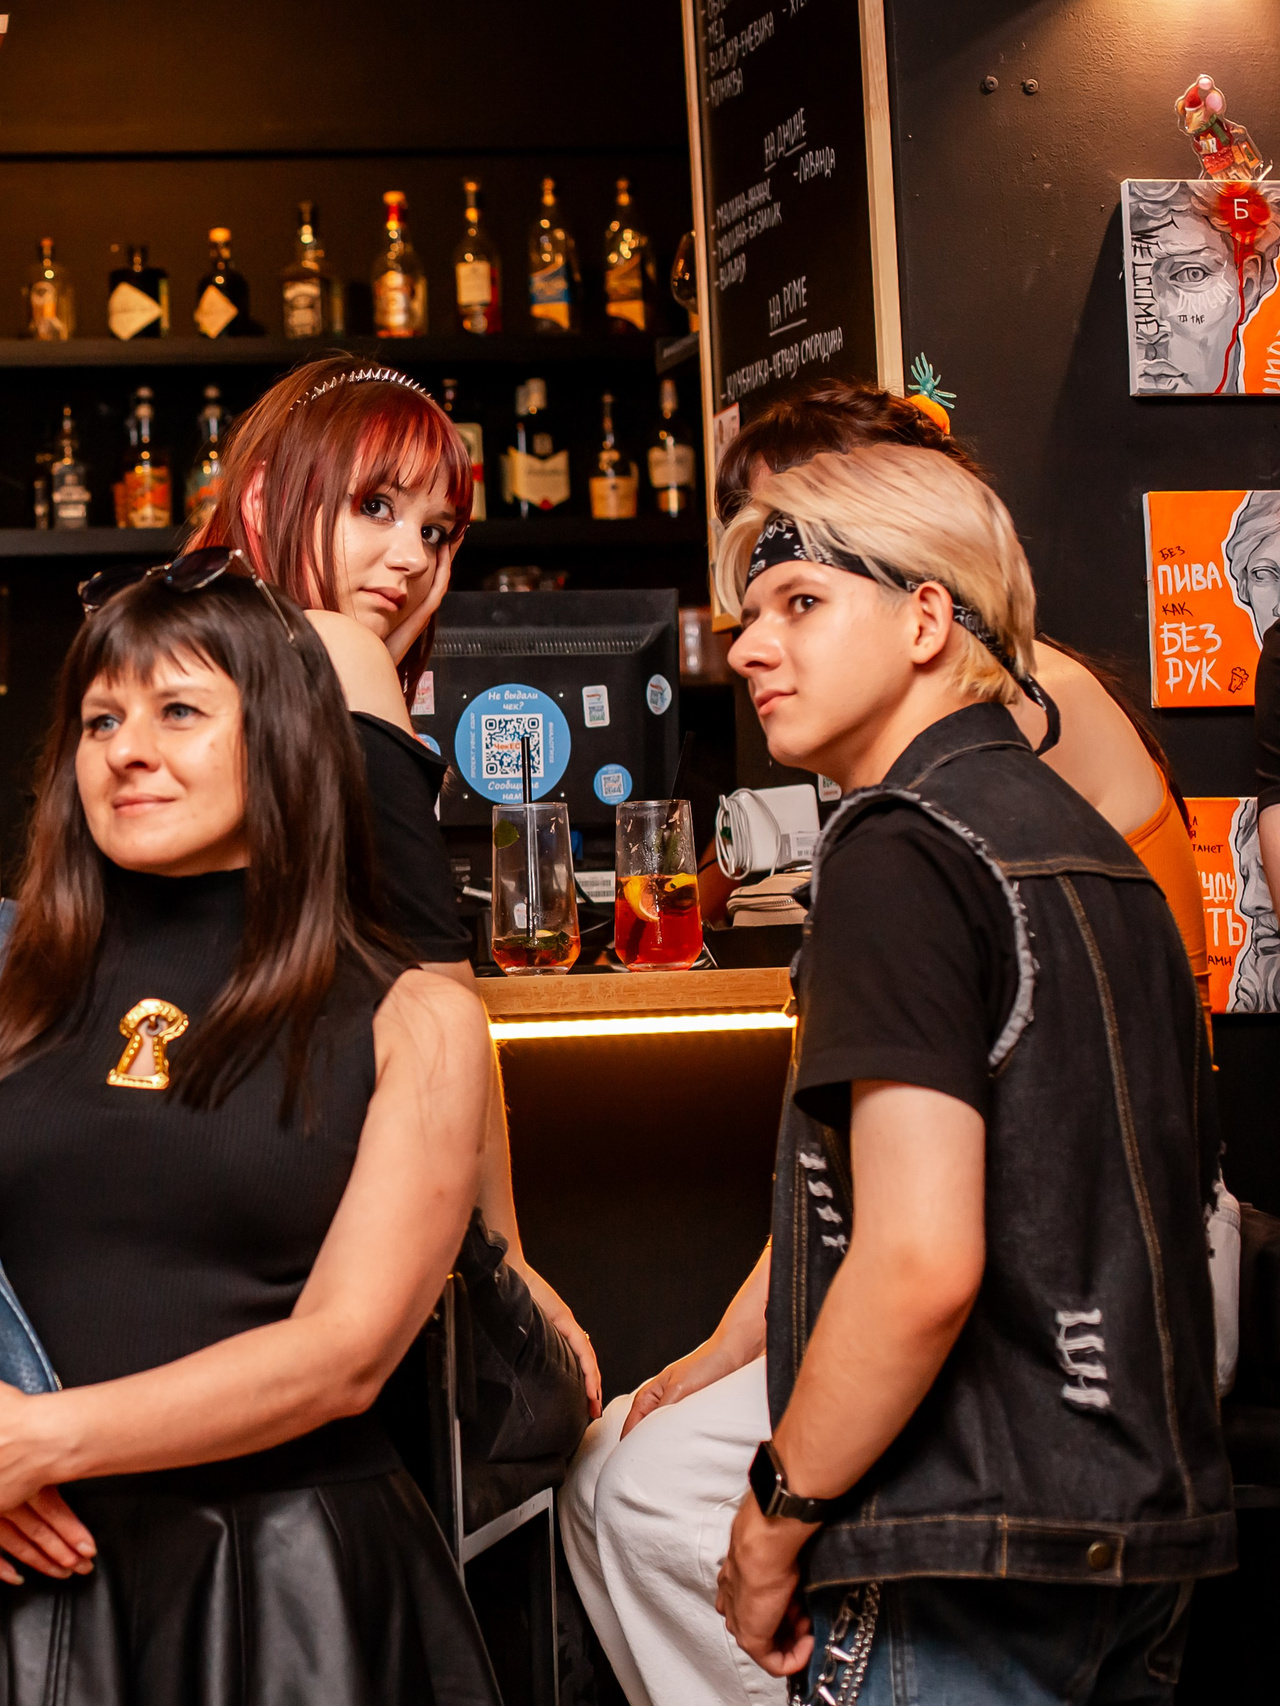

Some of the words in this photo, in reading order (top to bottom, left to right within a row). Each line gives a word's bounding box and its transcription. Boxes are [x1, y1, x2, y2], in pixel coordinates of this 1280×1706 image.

[764, 131, 776, 165] НА
[776, 107, 807, 159] ДЖИНЕ
[1233, 198, 1249, 220] Б
[1131, 216, 1176, 336] WELCOME
[769, 294, 782, 330] НА
[783, 275, 808, 318] РОМЕ
[1167, 271, 1235, 317] DRAGON
[800, 326, 844, 364] СМОРОДИНА
[1158, 545, 1186, 562] БЕЗ
[1157, 561, 1223, 596] ПИВА
[1161, 601, 1194, 618] КАК
[1159, 621, 1222, 656] БЕЗ
[1165, 656, 1222, 694] РУК
[488, 691, 501, 701] Не
[504, 690, 538, 700] выдали
[503, 701, 525, 711] чек?
[1197, 871, 1236, 904] УДУ
